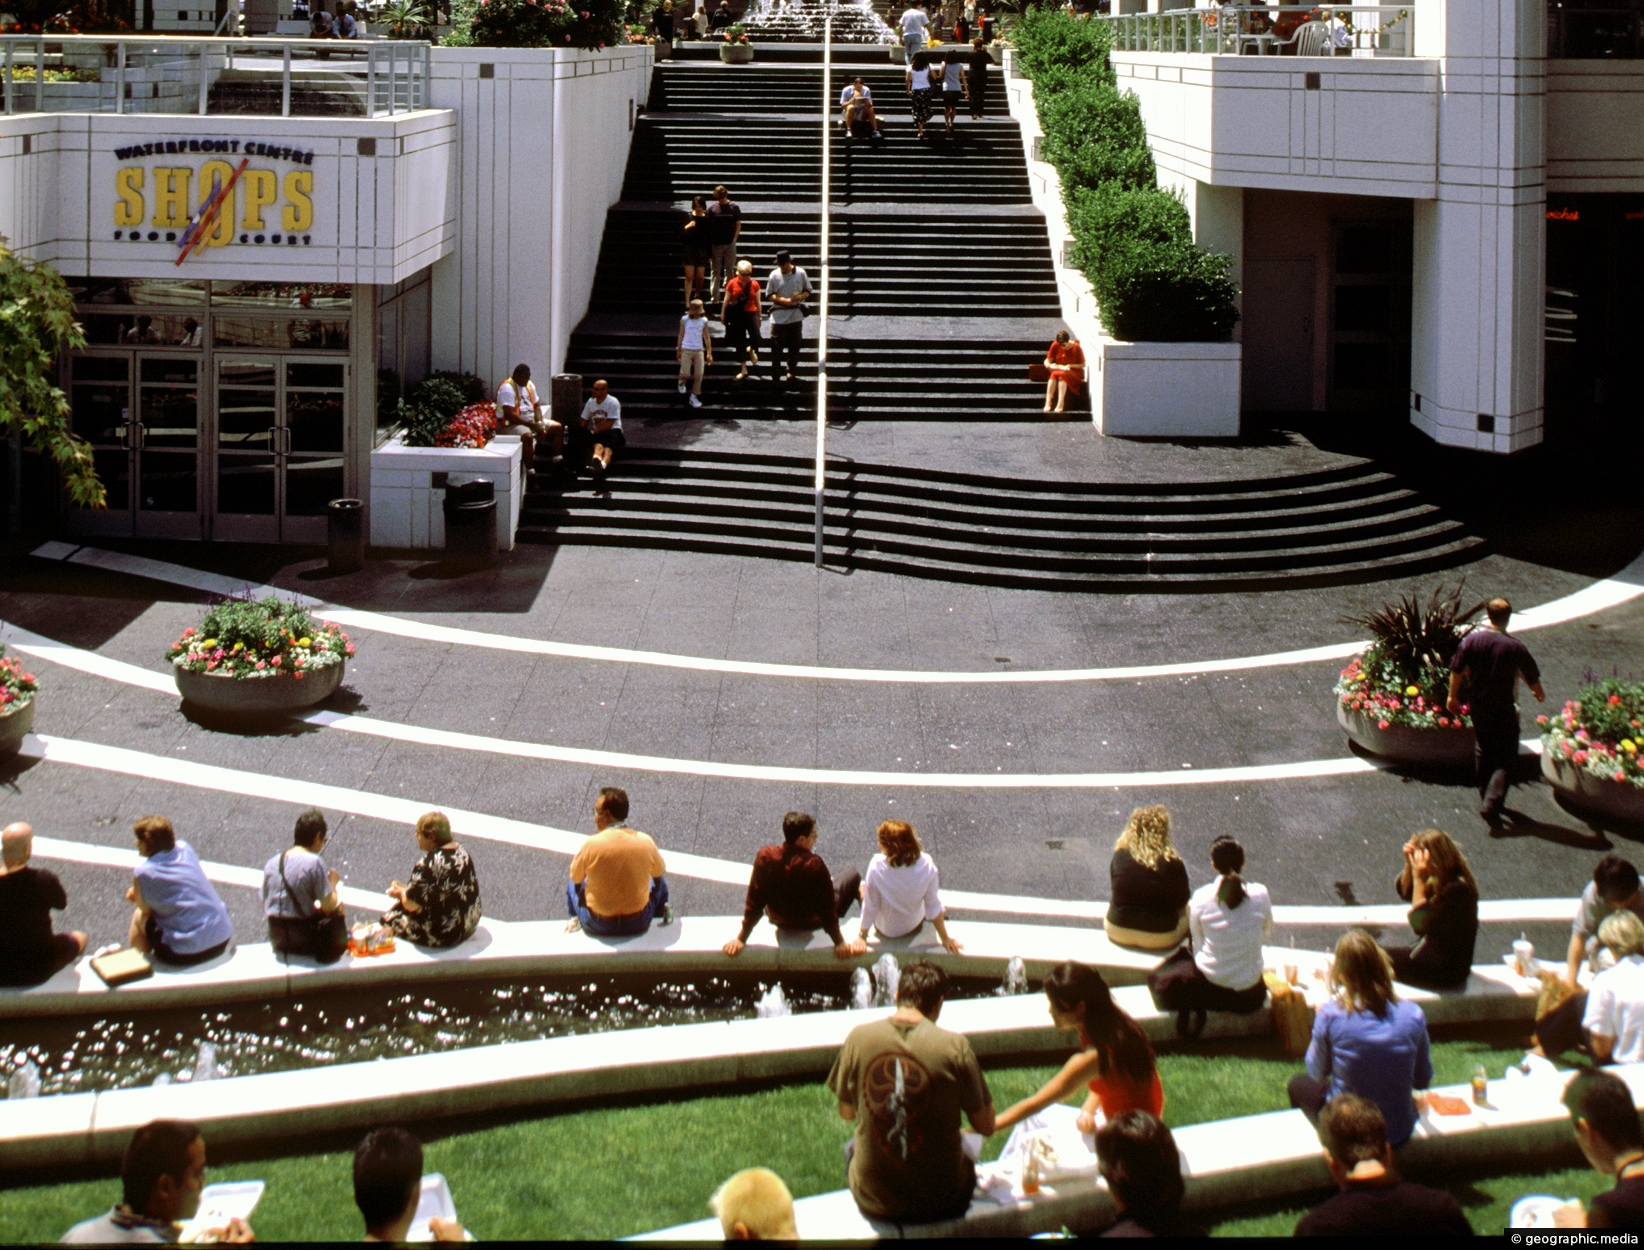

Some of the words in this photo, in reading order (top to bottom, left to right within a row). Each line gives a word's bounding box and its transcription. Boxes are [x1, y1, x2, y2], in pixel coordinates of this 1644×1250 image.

[114, 140, 240, 160] WATERFRONT
[244, 142, 314, 165] CENTRE
[114, 160, 313, 247] SHOPS
[114, 231, 176, 240] FOOD
[239, 234, 311, 245] COURT
